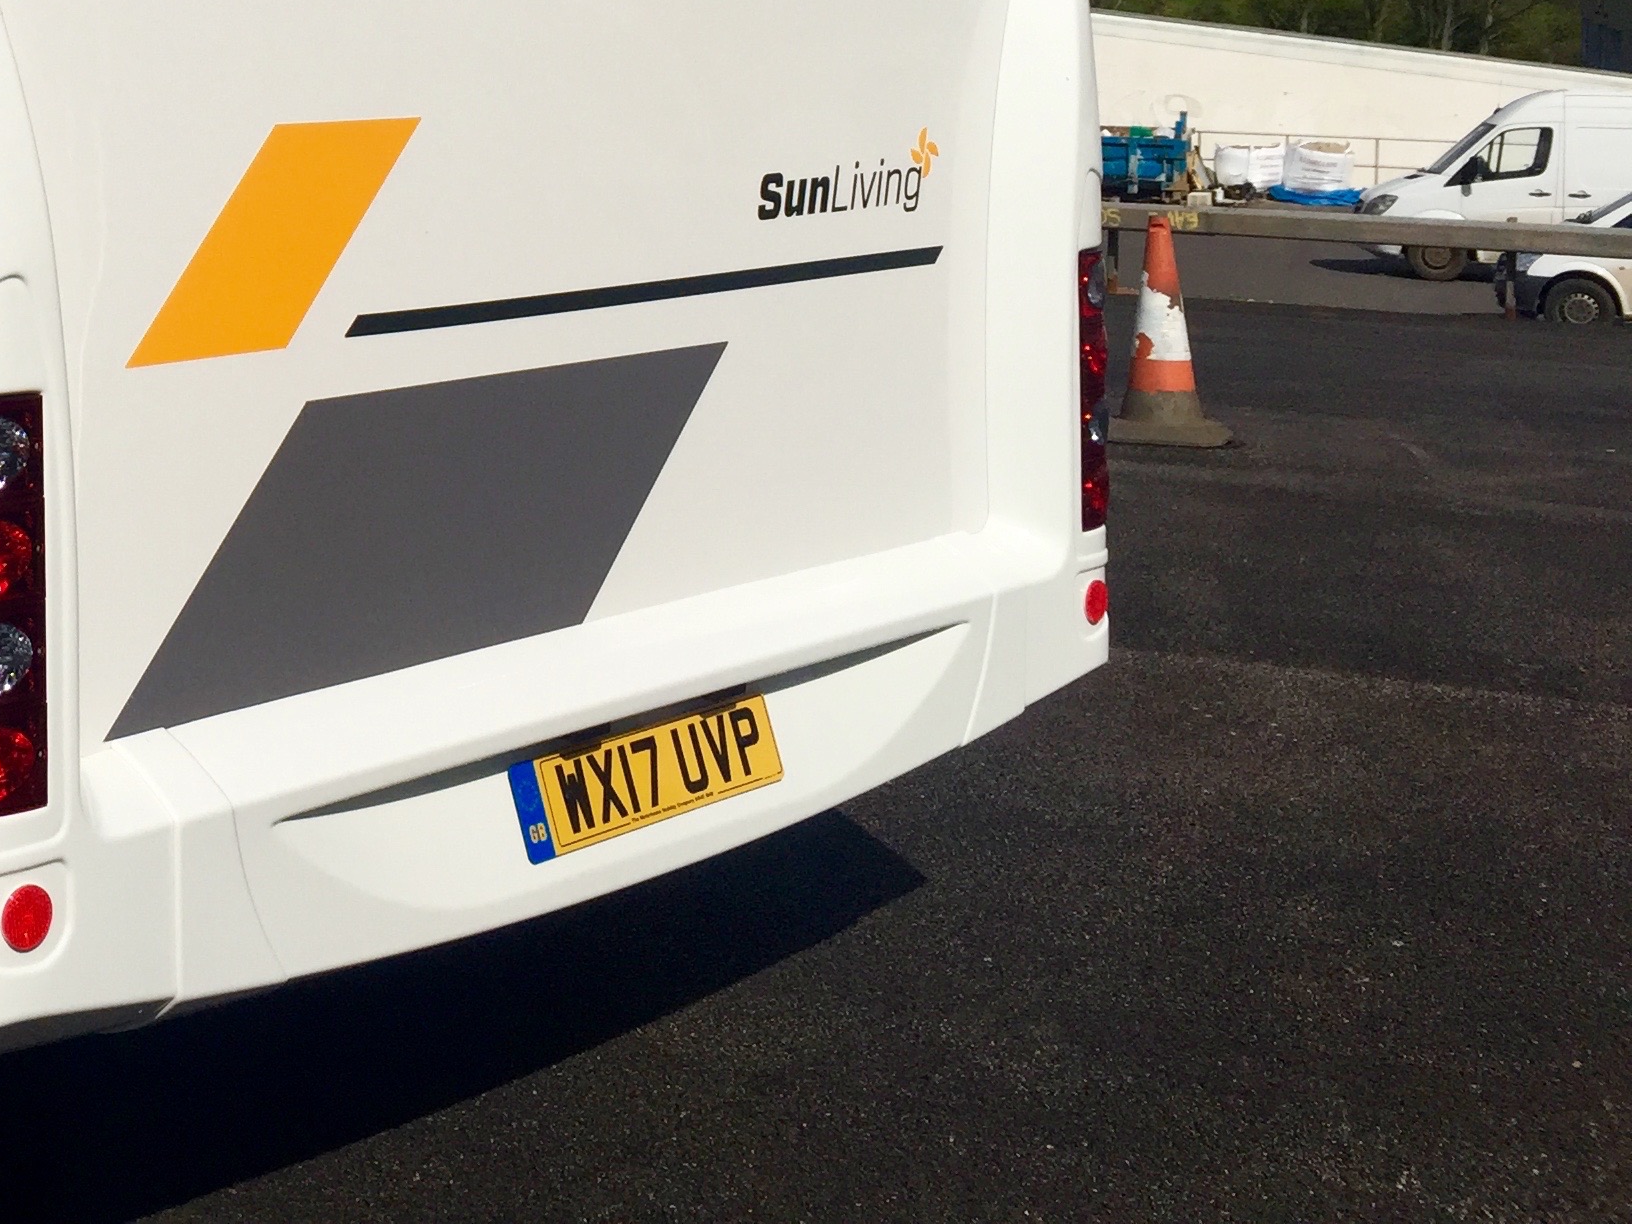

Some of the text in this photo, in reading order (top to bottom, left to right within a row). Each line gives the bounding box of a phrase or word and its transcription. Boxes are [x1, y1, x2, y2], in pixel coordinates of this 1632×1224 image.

[757, 158, 923, 221] SunLiving
[554, 706, 760, 834] WX17 UVP
[529, 822, 548, 844] GB
